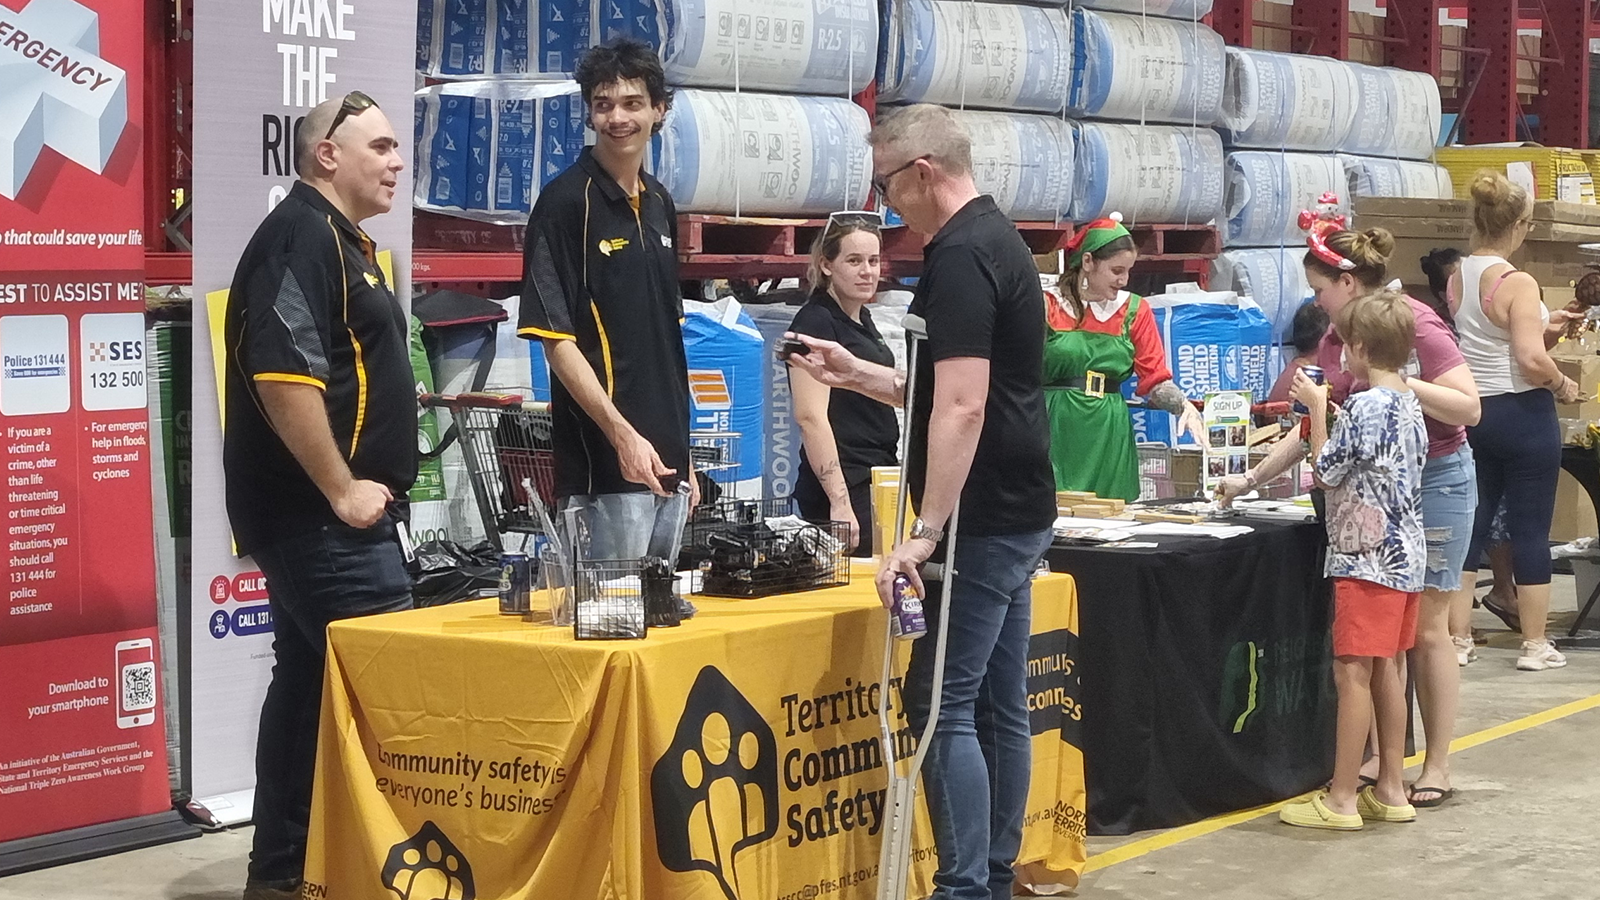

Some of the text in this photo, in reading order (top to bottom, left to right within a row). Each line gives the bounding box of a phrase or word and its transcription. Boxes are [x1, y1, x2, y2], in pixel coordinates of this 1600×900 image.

[262, 0, 356, 41] MAKE
[817, 28, 842, 51] R-2.5
[277, 43, 338, 108] THE
[4, 228, 143, 249] that could save your life
[32, 283, 50, 303] TO
[54, 282, 113, 302] ASSIST
[117, 282, 144, 301] ME?
[109, 340, 143, 361] SES
[4, 353, 66, 367] Police 131 444
[1249, 345, 1261, 391] SHIELD
[1178, 344, 1196, 397] SOUND
[1194, 344, 1211, 393] SHIELD
[90, 370, 144, 389] 132 500
[1213, 400, 1243, 411] SIGN UP
[7, 427, 52, 440] If you are a
[91, 422, 106, 432] For
[8, 441, 51, 454] victim of a
[91, 437, 113, 450] help
[113, 437, 122, 447] in
[8, 457, 57, 471] crime, other
[93, 451, 139, 464] storms and
[8, 473, 44, 487] than life
[92, 468, 130, 482] cyclones
[8, 489, 59, 503] threatening
[8, 503, 66, 519] or time critical
[9, 523, 56, 535] emergency
[9, 537, 68, 551] situations, you
[9, 552, 54, 567] should call
[10, 568, 56, 583] 131 444 for
[238, 578, 256, 592] CALL
[9, 587, 37, 601] police
[10, 602, 53, 615] assistance
[238, 611, 269, 627] CALL 131
[48, 676, 109, 696] Download to
[28, 695, 109, 719] your smartphone
[9, 758, 41, 769] initiative
[41, 755, 50, 764] of
[50, 754, 61, 763] the
[60, 748, 96, 761] Australian
[96, 740, 141, 754] Government,
[16, 771, 30, 781] and
[31, 766, 62, 778] Territory
[62, 759, 100, 772] Emergency
[101, 754, 129, 765] Services
[129, 751, 142, 760] and
[142, 748, 154, 759] the
[488, 756, 551, 789] safety
[0, 763, 145, 794] National Triple Zero Awareness Work Group
[786, 786, 887, 847] Safety
